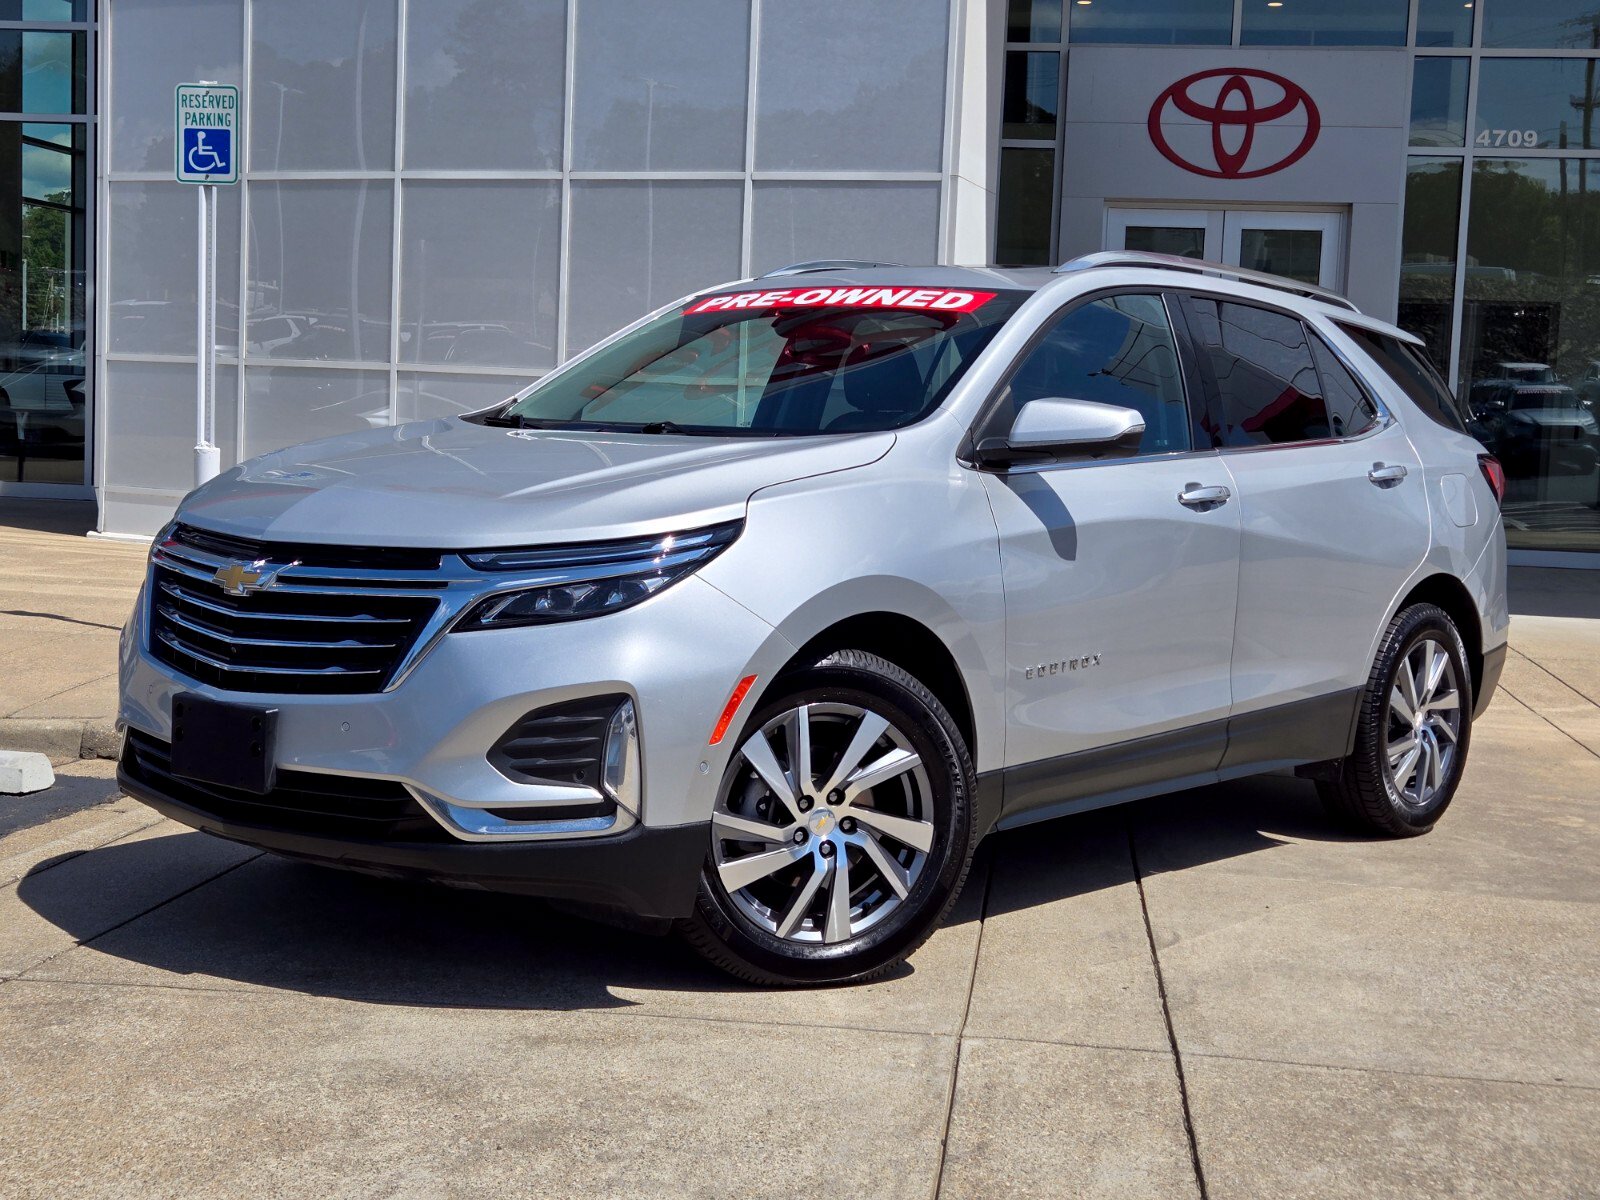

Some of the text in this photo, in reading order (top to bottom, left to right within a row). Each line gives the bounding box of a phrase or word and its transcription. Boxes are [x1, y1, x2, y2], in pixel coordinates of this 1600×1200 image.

[181, 94, 235, 109] RESERVED
[184, 112, 231, 127] PARKING
[1475, 129, 1538, 147] 4709
[693, 288, 974, 312] PRE-OWNED
[1025, 653, 1102, 680] EQUINOX
